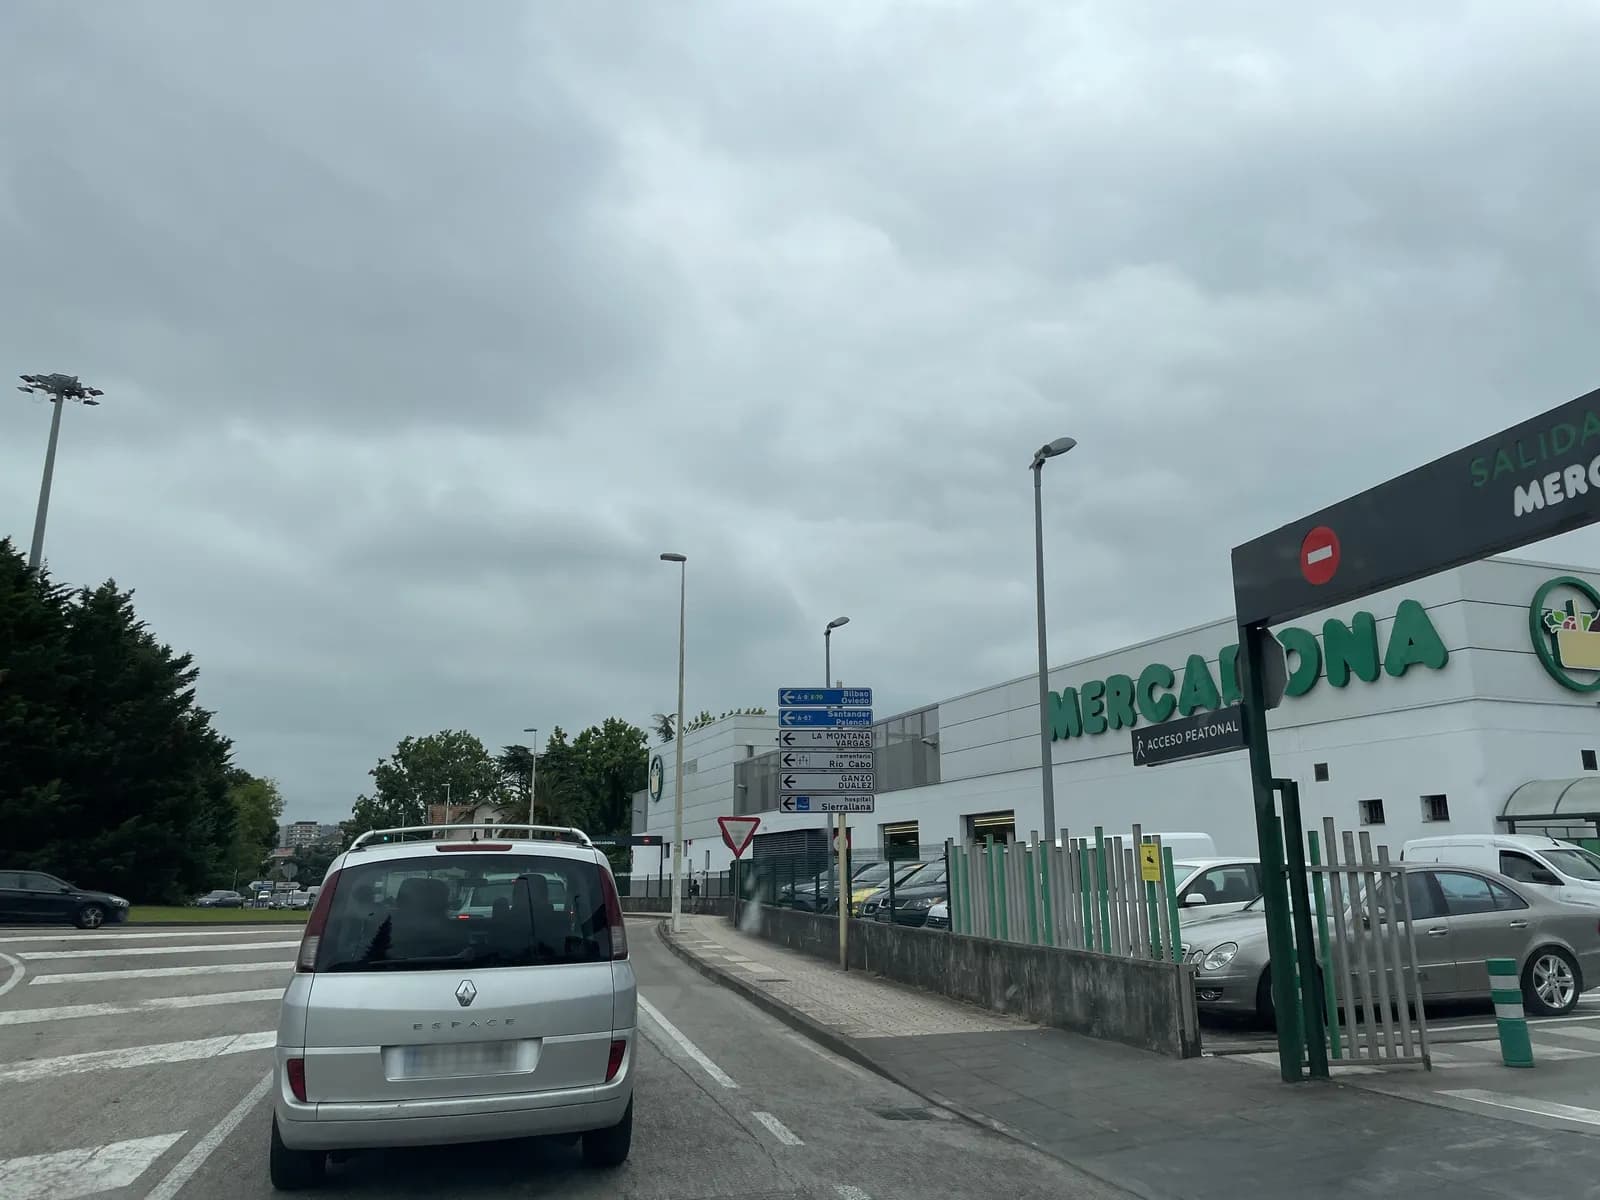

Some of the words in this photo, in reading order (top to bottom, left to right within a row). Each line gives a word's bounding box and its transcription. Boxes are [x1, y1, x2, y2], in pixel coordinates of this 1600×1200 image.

[1470, 410, 1600, 488] SALIDA
[843, 689, 869, 697] Bilbao
[836, 718, 870, 726] Palencia
[811, 732, 822, 740] LA
[1147, 733, 1183, 751] ACCESO
[1185, 720, 1239, 742] PEATONAL
[848, 760, 871, 768] Cabo
[841, 774, 872, 782] GANZO
[821, 803, 871, 811] Sierrallana
[413, 1018, 516, 1030] ESPACE
